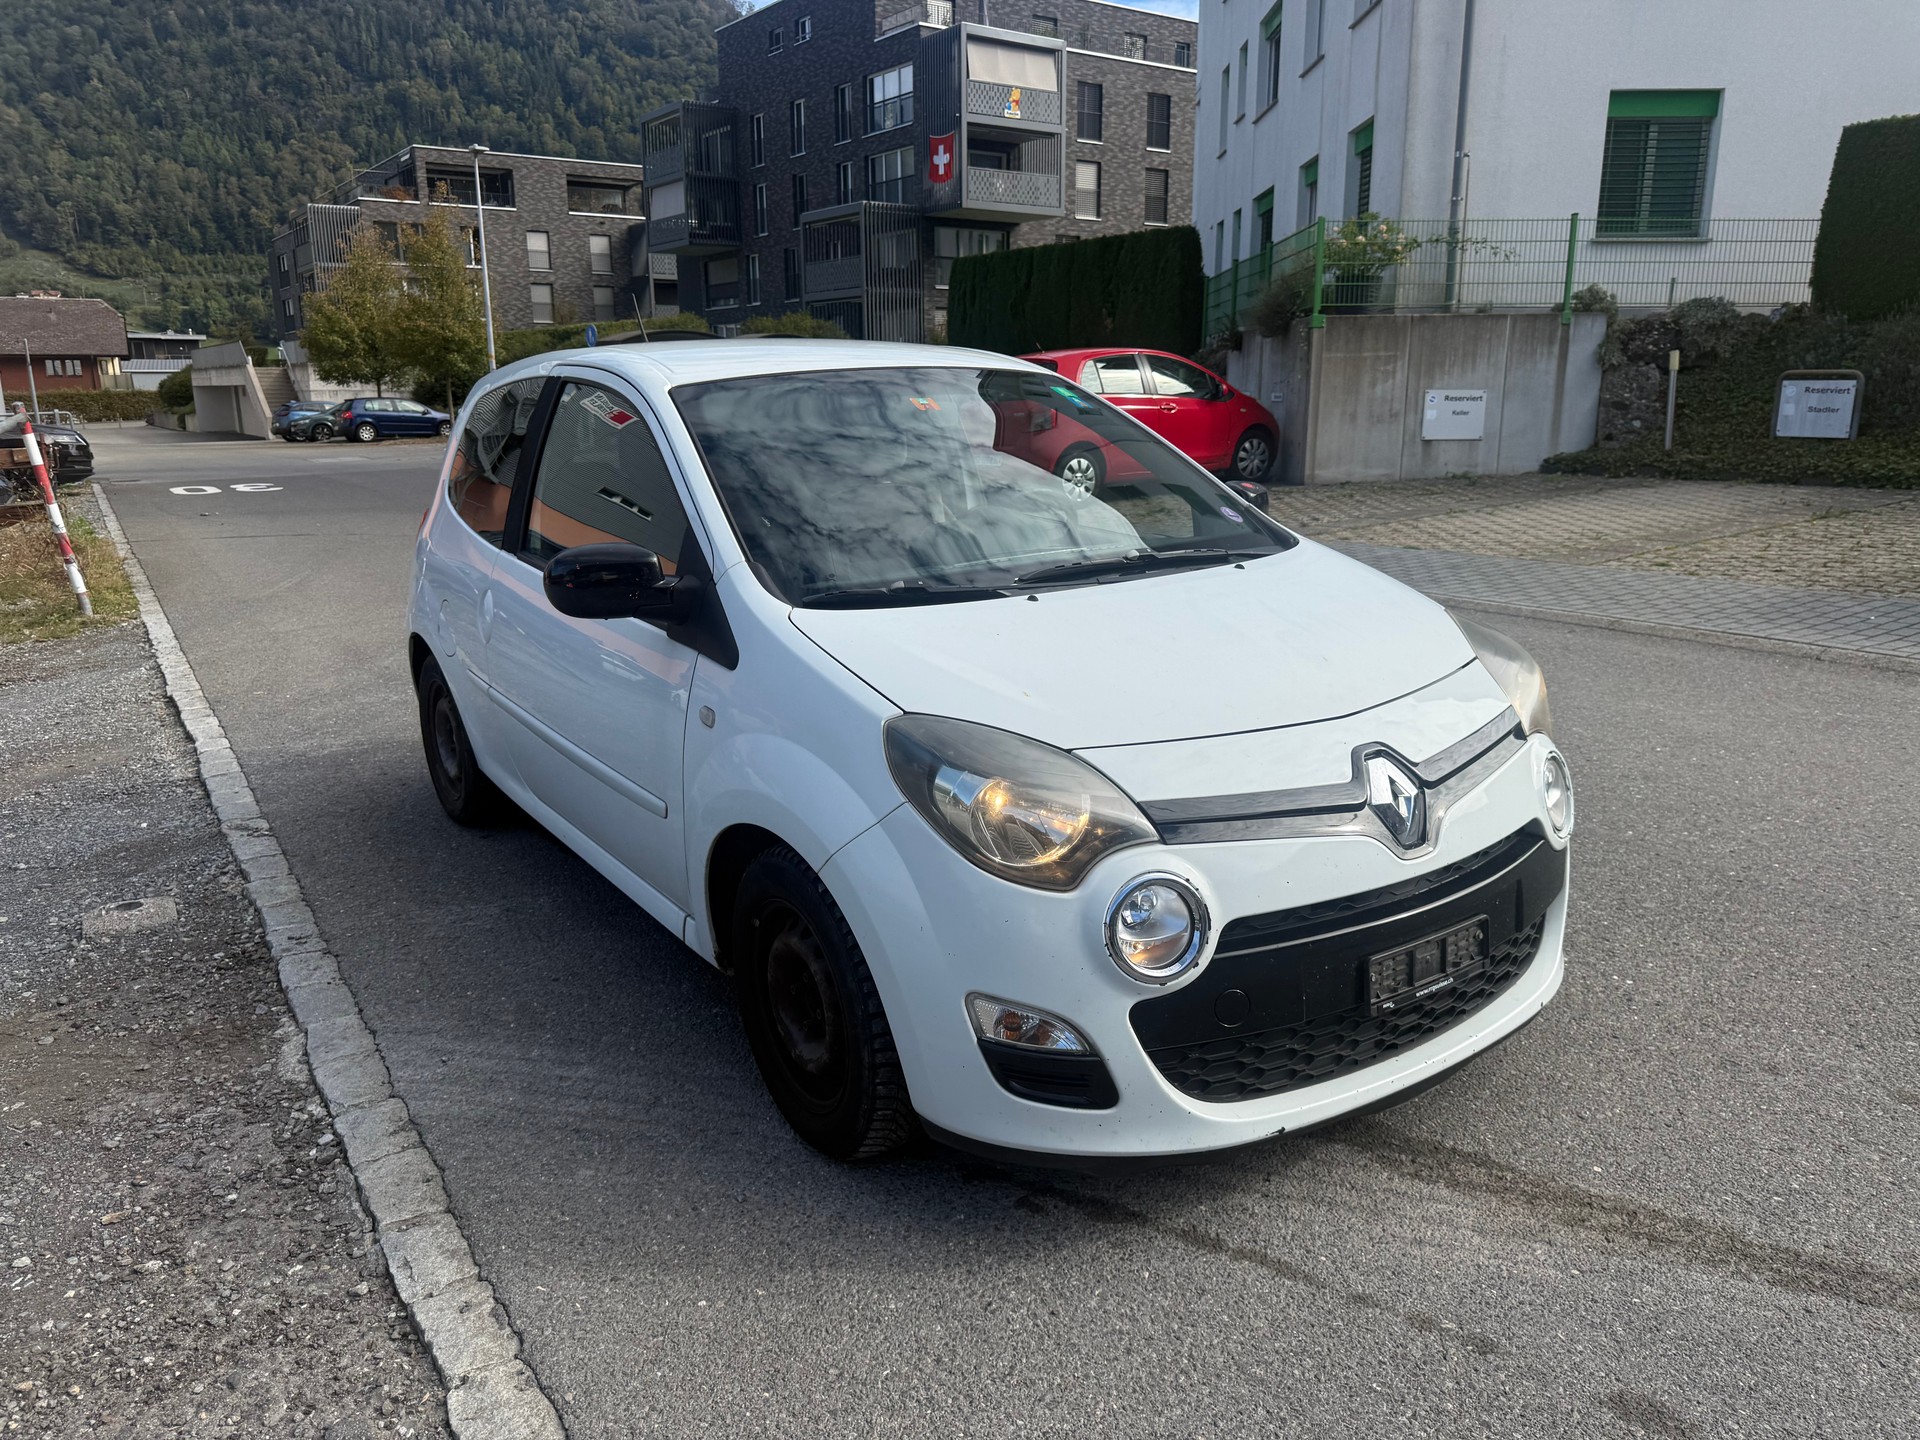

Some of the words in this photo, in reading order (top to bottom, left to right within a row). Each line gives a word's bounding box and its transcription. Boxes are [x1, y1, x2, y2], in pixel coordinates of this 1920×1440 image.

[1805, 386, 1851, 394] Reserviert
[1444, 394, 1483, 402] Reserviert
[169, 483, 284, 495] 30
